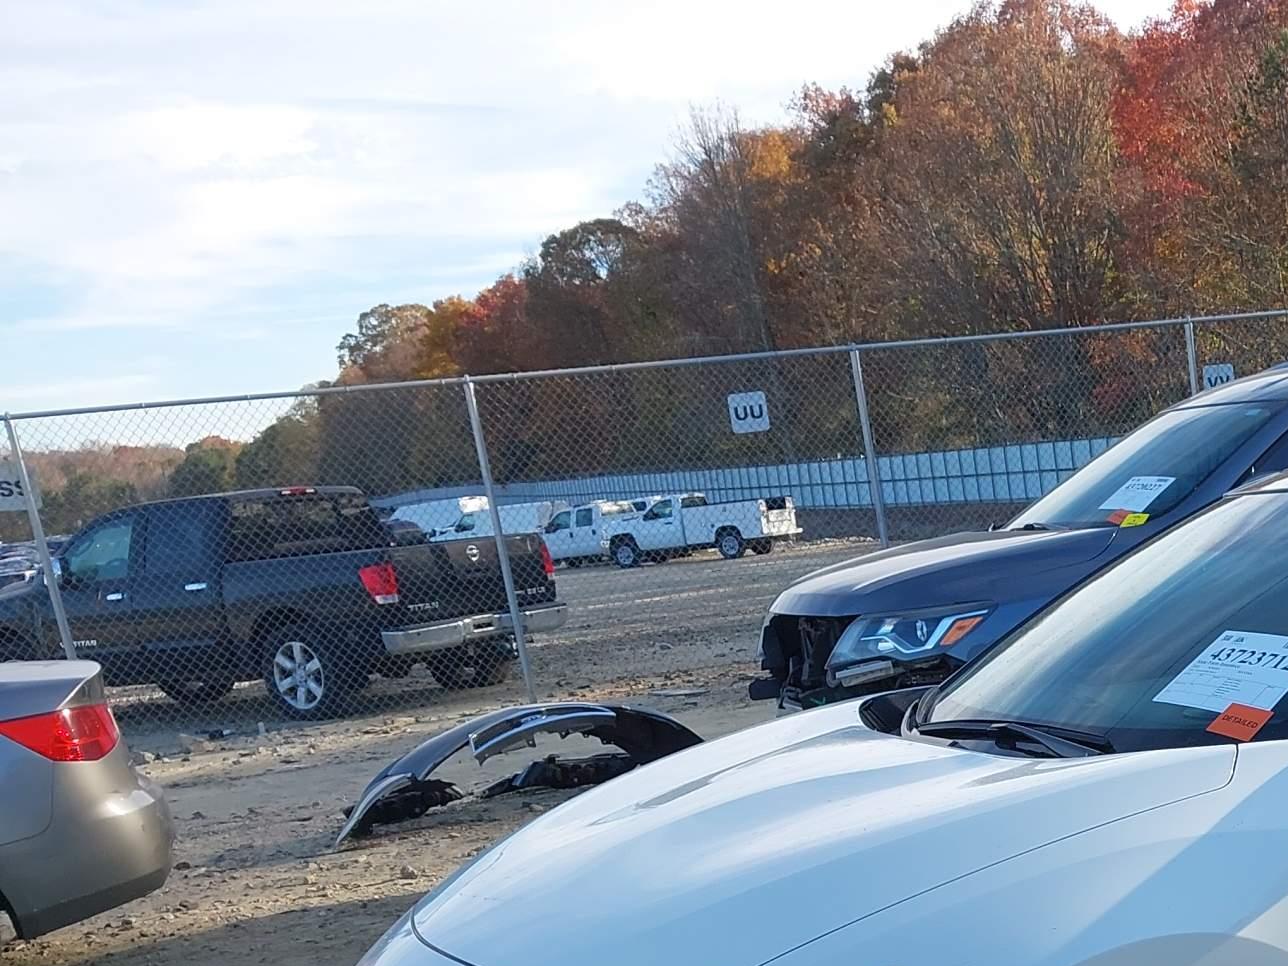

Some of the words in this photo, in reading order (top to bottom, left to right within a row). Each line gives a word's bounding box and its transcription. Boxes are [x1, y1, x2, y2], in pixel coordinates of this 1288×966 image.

[733, 404, 763, 420] UU
[407, 601, 439, 612] TITAN
[1221, 714, 1259, 729] DETAILED
